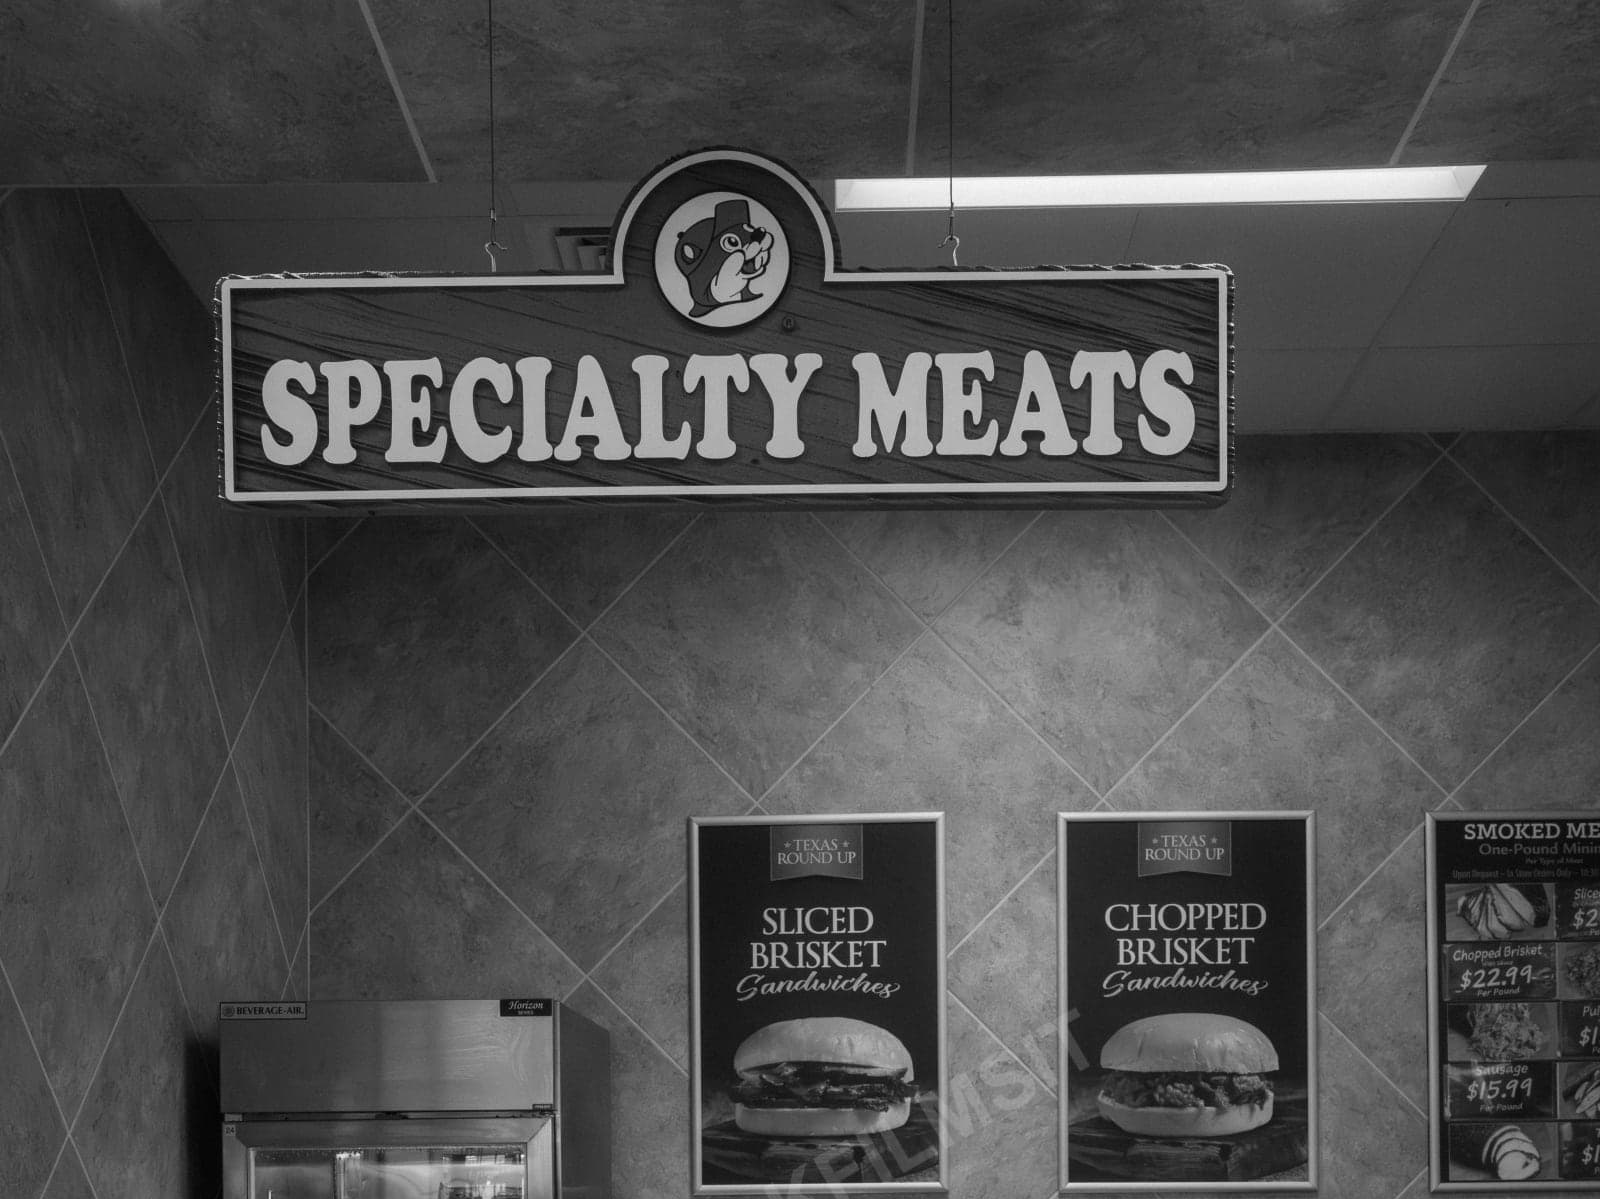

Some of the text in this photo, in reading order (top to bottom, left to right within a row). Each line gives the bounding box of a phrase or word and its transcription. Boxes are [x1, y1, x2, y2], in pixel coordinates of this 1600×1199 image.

[260, 348, 1196, 467] SPECIALTY MEATS
[1464, 822, 1560, 840] SMOKED
[793, 838, 838, 852] TEXAS
[1161, 834, 1207, 848] TEXAS
[1479, 842, 1558, 855] One-Pound
[777, 851, 857, 865] ROUND UP
[1145, 847, 1225, 861] ROUND UP
[762, 906, 874, 936] SLICED
[1104, 903, 1267, 932] CHOPPED
[750, 940, 887, 970] BRISKET
[1117, 937, 1255, 966] BRISKET
[1453, 944, 1543, 963] Chopped Brisket
[736, 971, 901, 1001] Sandwiches
[1102, 967, 1269, 998] Sandwiches
[1460, 964, 1533, 990] $22.99
[1493, 986, 1520, 996] Pound
[508, 1000, 544, 1010] Horizon
[1475, 1064, 1529, 1076] Sausage
[1466, 1077, 1533, 1101] $15.99
